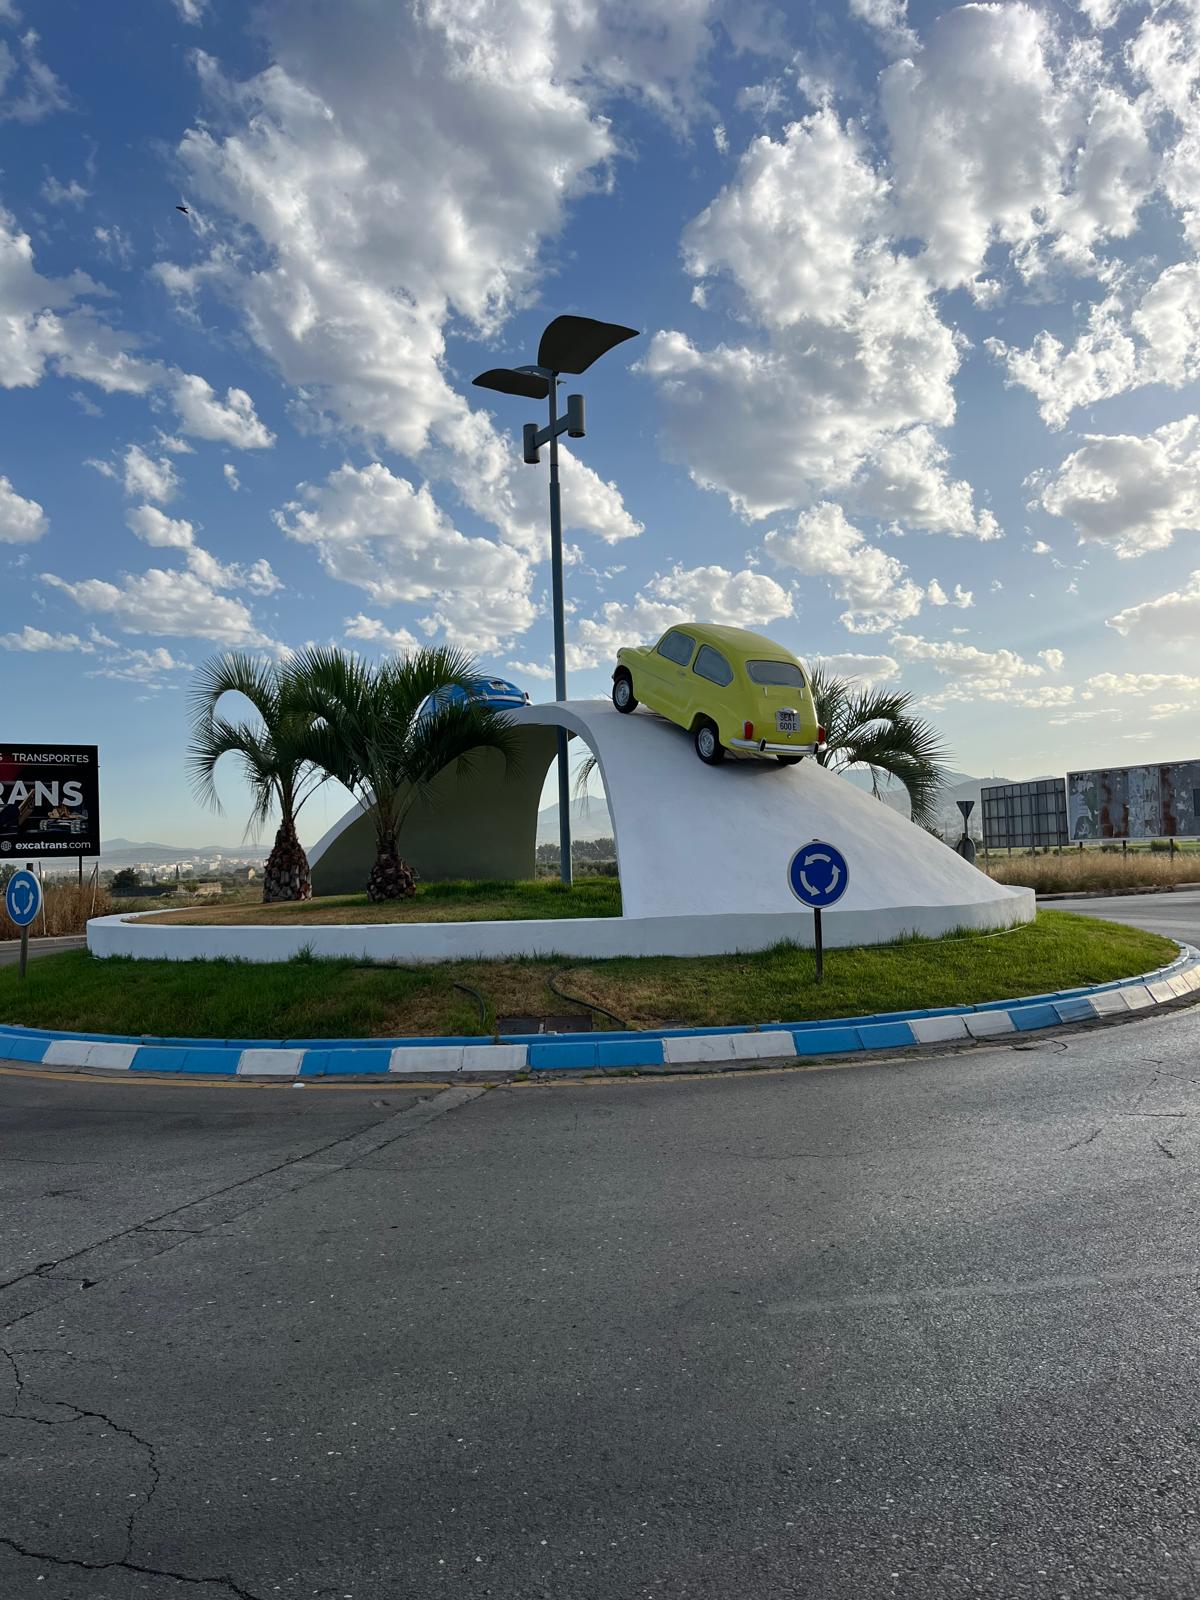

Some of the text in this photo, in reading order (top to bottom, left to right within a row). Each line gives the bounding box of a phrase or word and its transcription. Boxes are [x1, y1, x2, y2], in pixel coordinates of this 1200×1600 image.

[780, 712, 795, 722] SEAT
[779, 722, 797, 731] 600 E
[12, 753, 89, 763] TRANSPORTES
[0, 780, 83, 807] ANS
[15, 841, 91, 850] excatrans.com
